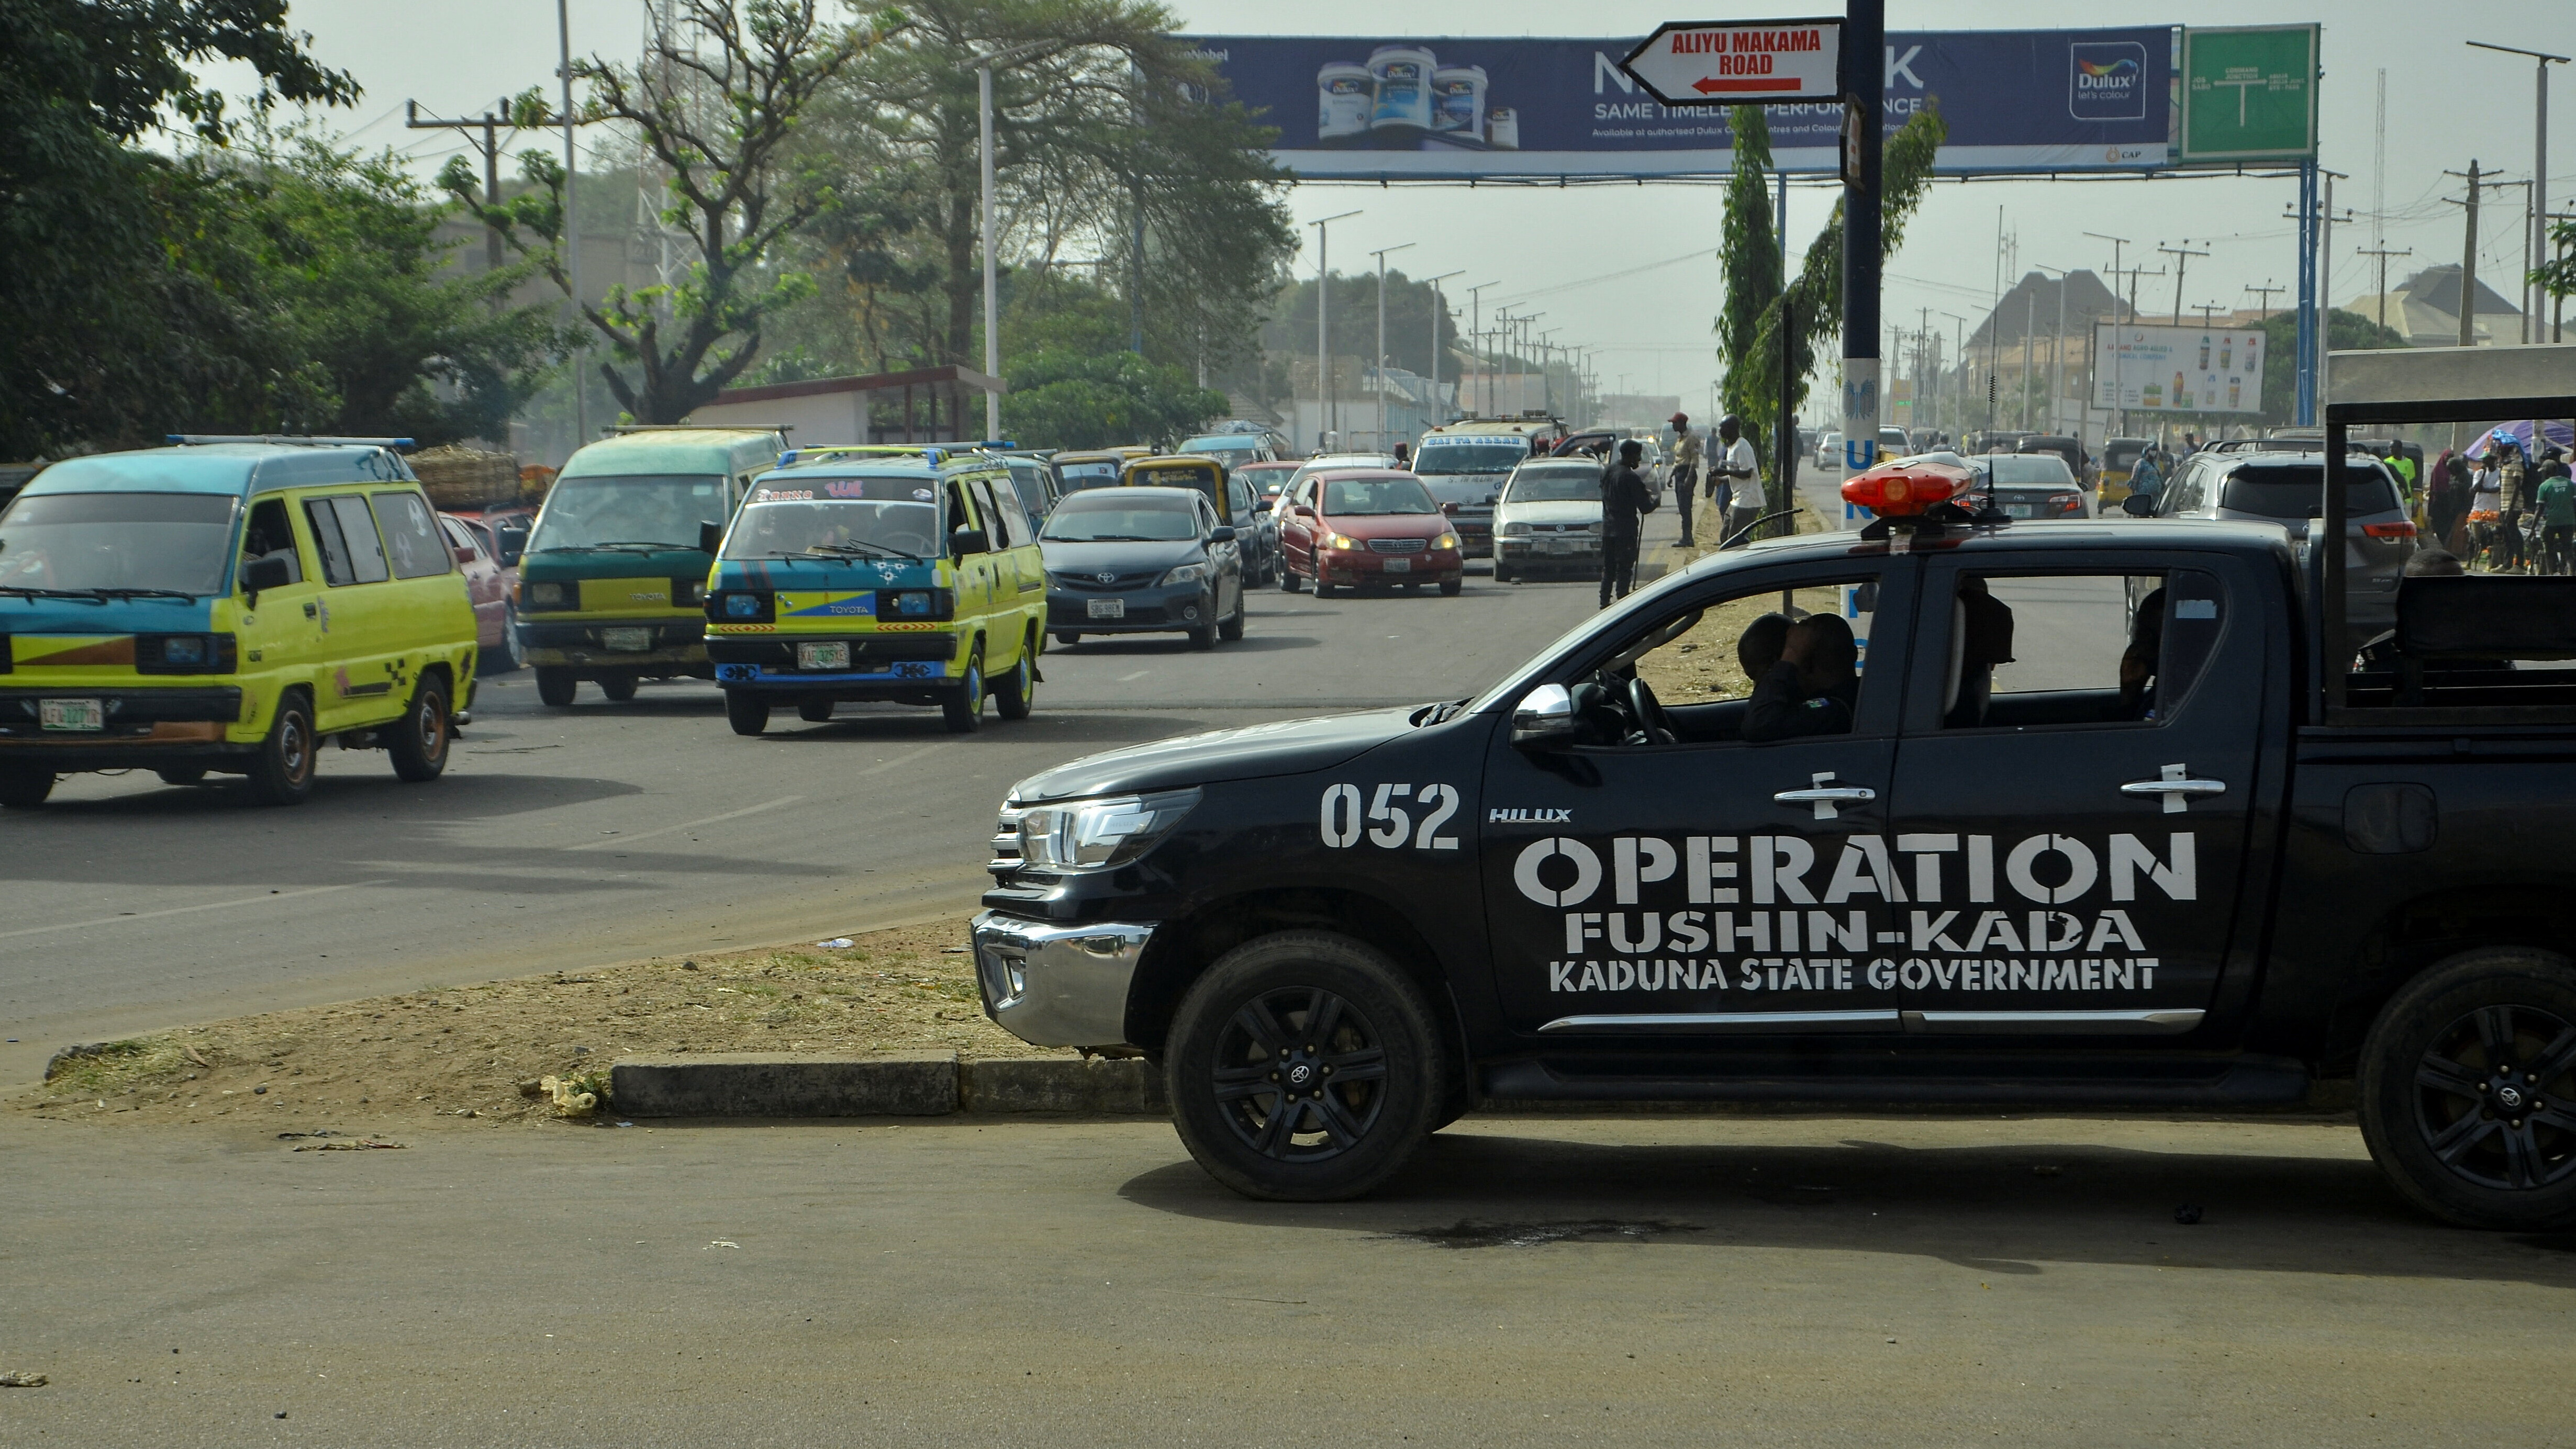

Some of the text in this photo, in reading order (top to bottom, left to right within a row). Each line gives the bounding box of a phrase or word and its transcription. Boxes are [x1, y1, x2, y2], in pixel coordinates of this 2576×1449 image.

[1672, 30, 1821, 53] ALIYU MAKAMA
[1719, 54, 1772, 75] ROAD
[2078, 73, 2131, 88] Dulux
[2078, 91, 2131, 99] let's colour
[1595, 103, 1653, 119] SAME
[1659, 103, 1731, 117] TIMELE
[1592, 128, 1634, 137] Available
[1647, 126, 1694, 135] authorised
[1697, 126, 1722, 134] Dulux
[1321, 783, 1459, 849] 052
[1489, 808, 1573, 823] HILUX
[1514, 832, 2197, 907] OPERATION
[1566, 910, 2146, 953] FUSHIN-KADA
[1550, 958, 2159, 992] KADUNA STATE GOVERNMENT
